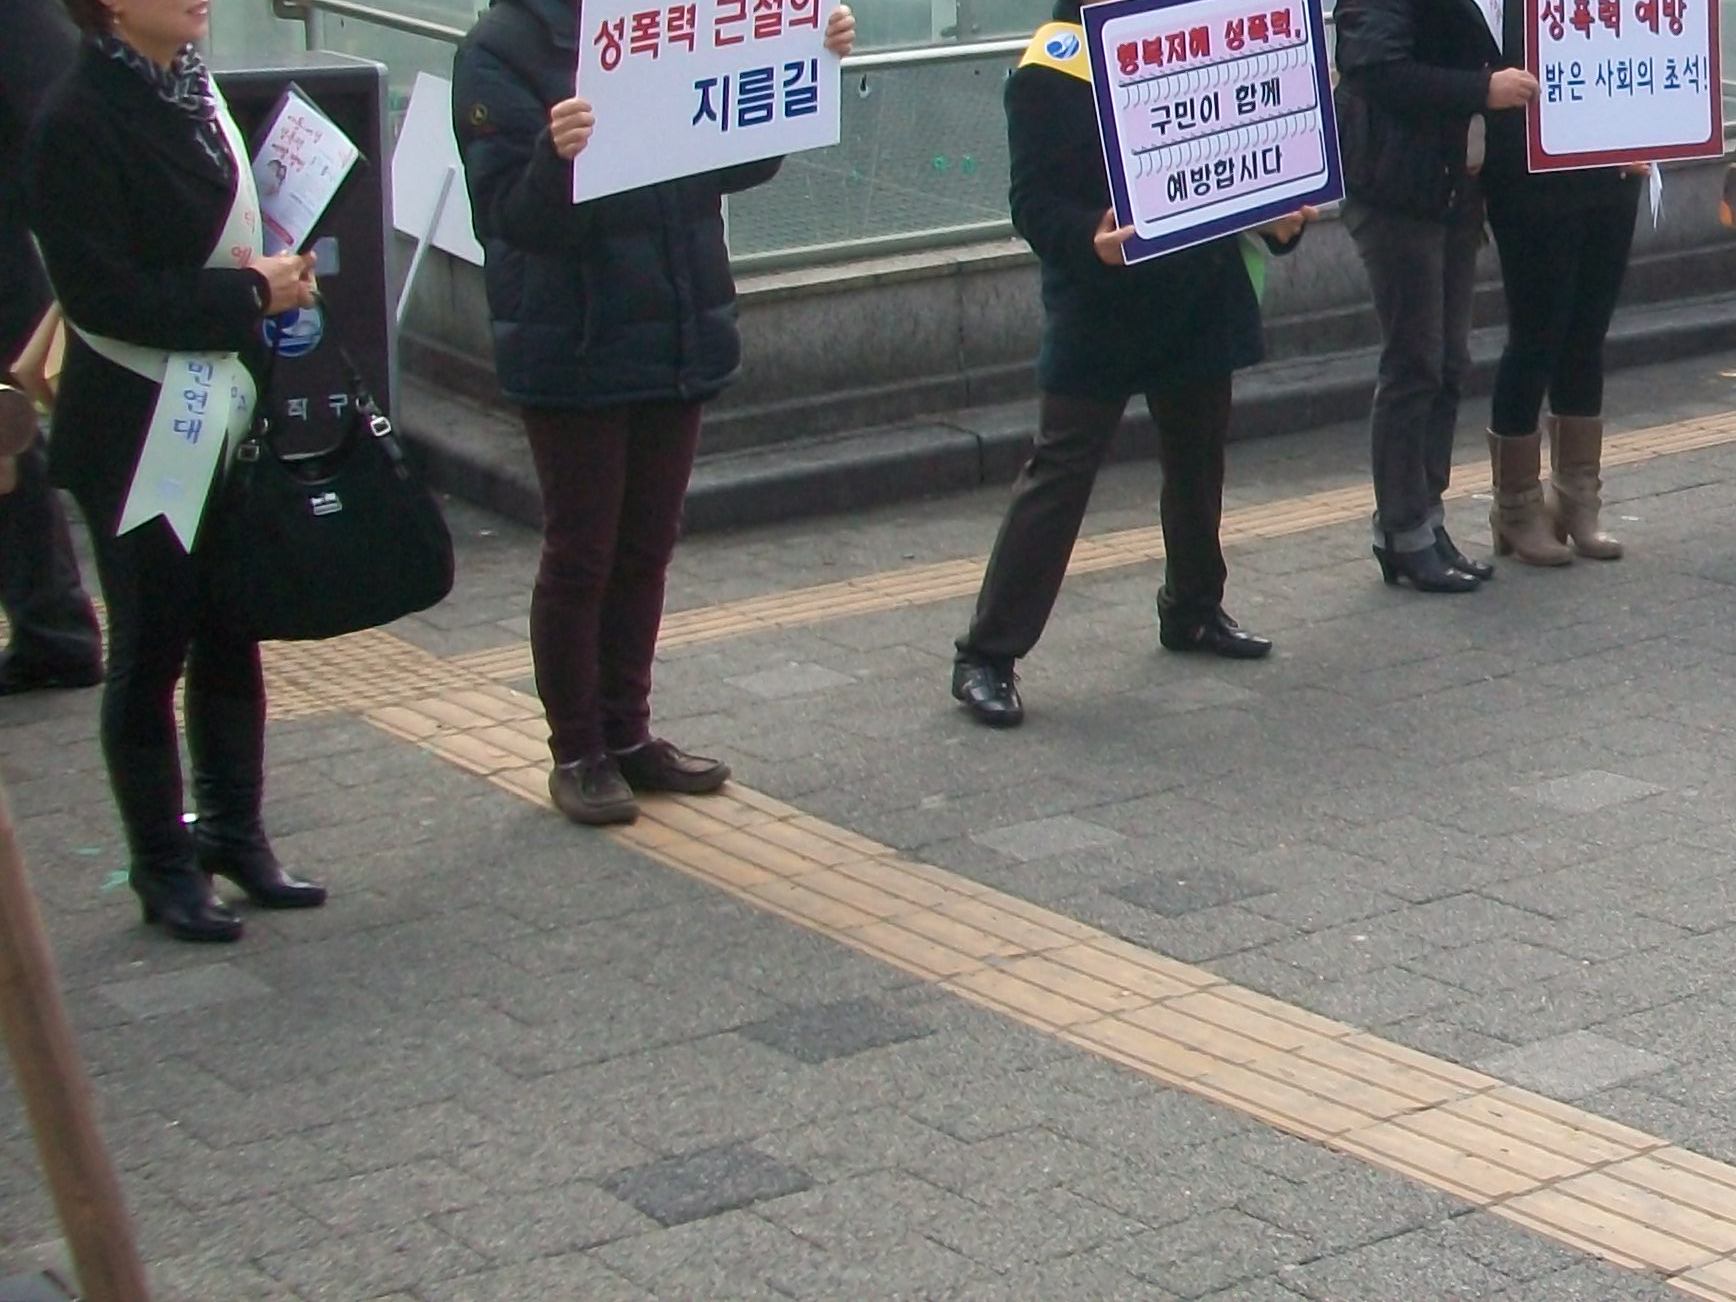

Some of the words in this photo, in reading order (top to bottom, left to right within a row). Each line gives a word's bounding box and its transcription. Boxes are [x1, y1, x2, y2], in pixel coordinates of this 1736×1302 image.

[593, 2, 697, 72] 성폭력
[691, 57, 819, 133] 지름길
[1150, 91, 1221, 136] 구민이
[1234, 77, 1282, 116] 함께
[1544, 58, 1585, 104] 밝은
[1594, 56, 1656, 97] 사회의
[1663, 52, 1709, 94] 초석!
[1166, 145, 1283, 203] 예방합시다
